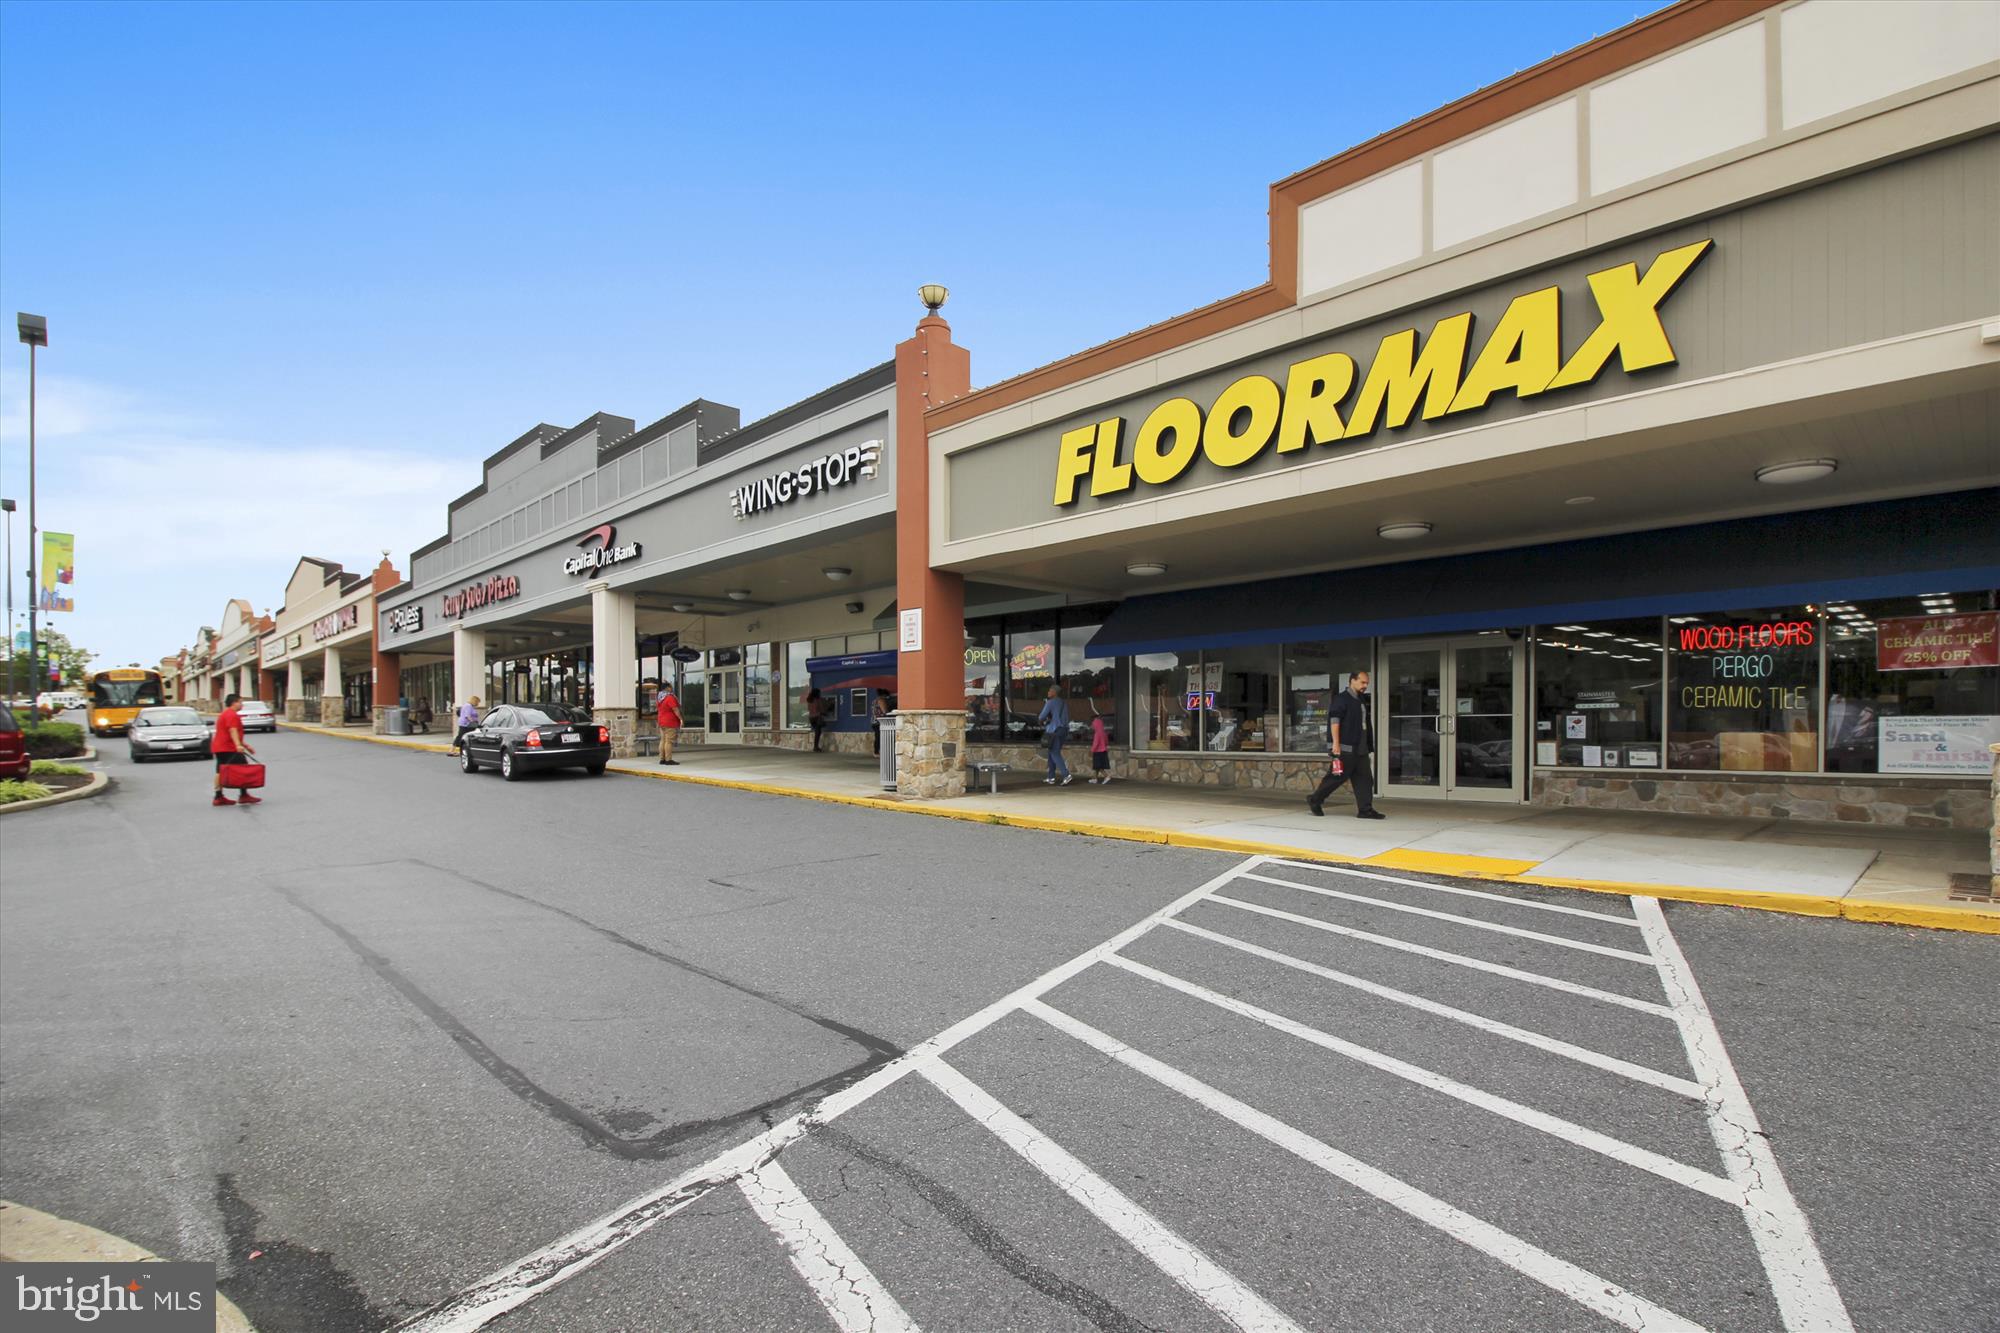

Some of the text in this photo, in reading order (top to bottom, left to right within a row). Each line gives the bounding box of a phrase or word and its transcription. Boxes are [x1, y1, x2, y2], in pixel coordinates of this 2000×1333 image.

[1053, 238, 1713, 506] FLOORMAX
[563, 542, 637, 575] Capital One Bank
[1680, 621, 1813, 651] WOOD FLOORS
[1884, 631, 1993, 649] CERAMIC TILE
[964, 648, 997, 666] OPEN
[1903, 649, 1972, 664] 25% OFF
[1190, 664, 1221, 675] CAPET
[1712, 654, 1773, 678] PERGO
[1190, 682, 1219, 691] THGS
[1188, 695, 1213, 708] OPN
[1681, 685, 1806, 710] CERAMIC TILE
[1885, 730, 1946, 742] Sand
[1911, 749, 1991, 762] Finish
[1935, 743, 1947, 752] &
